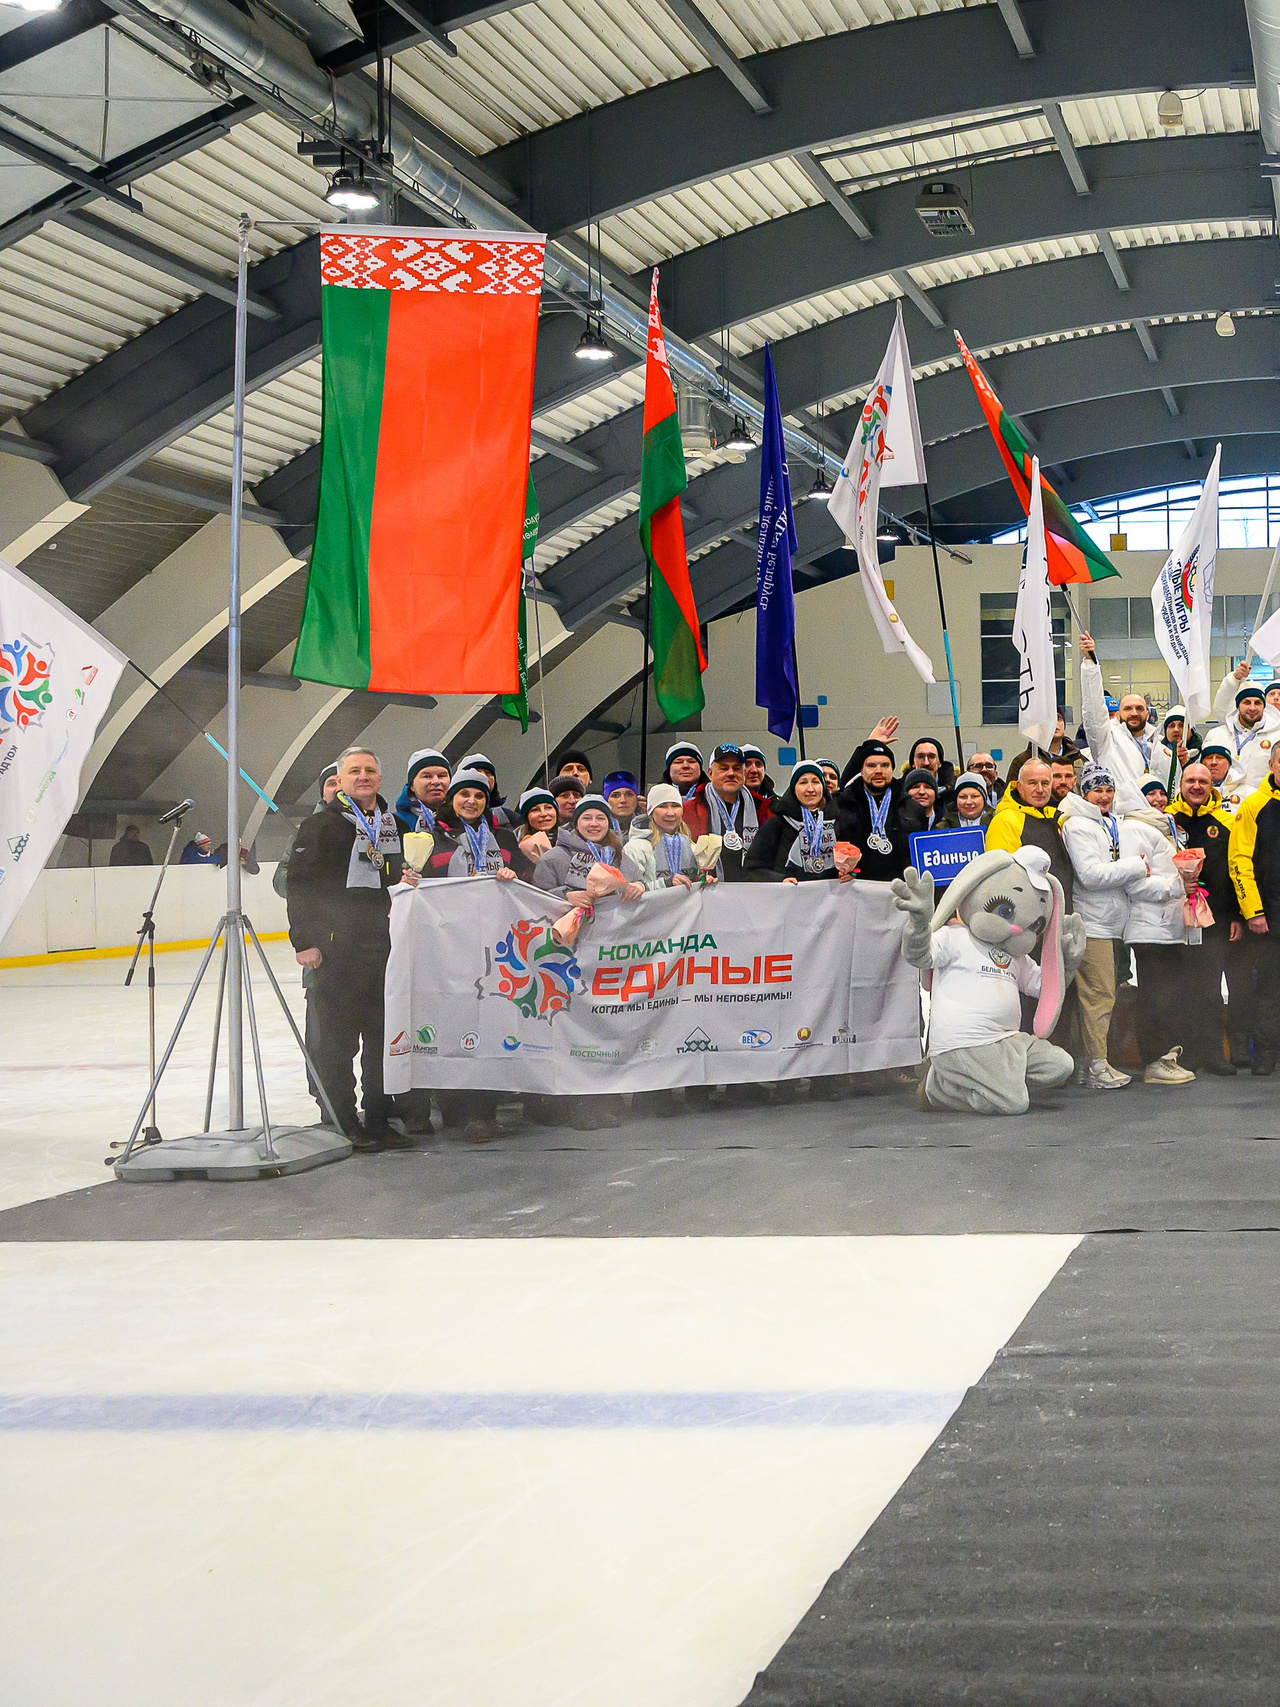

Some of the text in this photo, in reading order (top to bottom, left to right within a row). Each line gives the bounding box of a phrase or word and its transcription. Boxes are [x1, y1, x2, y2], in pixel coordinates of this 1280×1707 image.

[1174, 596, 1190, 634] ТИГРЫ
[598, 934, 718, 961] КОМАНДА
[591, 954, 793, 1002] ЕДИНЫЕ
[591, 1005, 624, 1015] КОГДА
[626, 1002, 645, 1012] МЫ
[647, 996, 679, 1010] ЕДИНЫ
[694, 994, 713, 1003] МЫ
[716, 991, 793, 1003] НЕПОБЕДИМЫ!
[570, 1049, 620, 1059] ВОСТОЧНЫЙ
